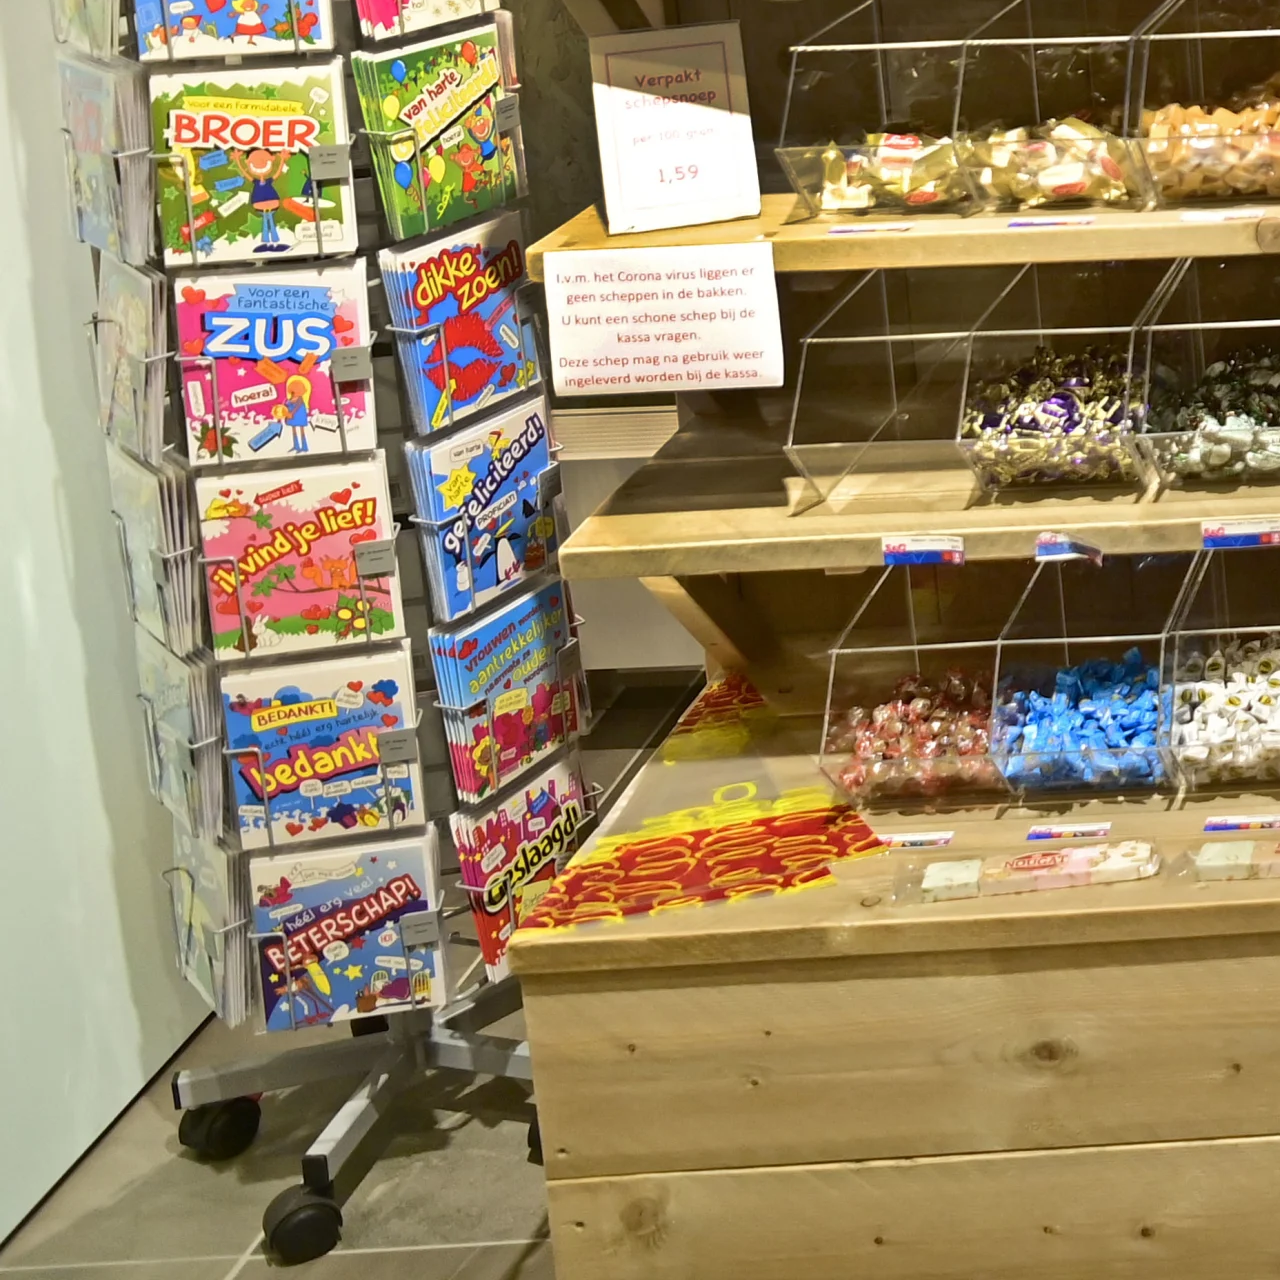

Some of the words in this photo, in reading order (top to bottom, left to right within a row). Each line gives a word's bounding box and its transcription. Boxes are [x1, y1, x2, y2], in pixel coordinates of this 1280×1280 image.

[635, 68, 702, 89] Verpakt
[188, 100, 211, 108] voor
[235, 100, 298, 113] formidabele
[403, 98, 427, 120] van
[426, 71, 458, 101] harte
[625, 90, 717, 110] schepsnoep
[174, 113, 316, 148] BROER
[443, 130, 462, 143] hoera!
[659, 164, 699, 185] 1,59
[416, 252, 477, 306] dikke
[457, 246, 519, 311] zoen!
[594, 272, 614, 282] het
[618, 271, 662, 282] Corona
[666, 270, 696, 280] virus
[700, 267, 738, 280] liggen
[742, 267, 754, 276] er
[237, 297, 330, 311] fantastische
[284, 288, 310, 298] een
[567, 293, 596, 305] geen
[600, 290, 658, 303] scheppen
[663, 289, 673, 300] in
[678, 288, 693, 299] de
[697, 286, 747, 298] bakken.
[562, 316, 571, 326] U
[575, 314, 601, 325] kunt
[605, 316, 628, 324] een
[633, 312, 676, 323] schone
[680, 311, 717, 322] schep
[720, 309, 736, 320] bij
[740, 308, 755, 319] de
[206, 317, 331, 357] ZUS
[617, 332, 650, 343] kassa
[654, 332, 701, 343] vragen.
[559, 357, 589, 368] Deze
[593, 356, 628, 368] schep
[633, 355, 659, 366] mag
[664, 354, 678, 363] na
[682, 352, 729, 365] gebruik
[733, 350, 764, 360] weer
[565, 374, 630, 388] ingeleverd
[635, 371, 683, 383] worden
[687, 370, 701, 383] bij
[706, 368, 720, 379] de
[725, 368, 762, 378] kassa.
[234, 387, 274, 404] hoera!
[454, 449, 465, 457] van
[444, 417, 544, 554] gefeliciteerd!
[447, 473, 461, 493] van
[449, 476, 471, 502] harte
[259, 491, 281, 504] super
[477, 493, 516, 525] PROFICIAT!
[213, 568, 245, 594] ik
[239, 529, 291, 573] vind
[287, 522, 320, 555] je
[319, 500, 374, 533] lief!
[465, 622, 516, 672] vrouwen
[518, 603, 543, 626] worden
[469, 607, 562, 694] aantrekkelijker
[484, 657, 521, 695] naarmate
[522, 649, 531, 661] ze
[512, 643, 552, 682] ouder
[257, 701, 334, 727] BEDANKT!
[264, 737, 286, 750] echt
[315, 721, 333, 733] erg
[335, 709, 379, 727] hartelijk
[488, 806, 580, 906] Geslaagd!
[1004, 854, 1067, 869] NOUGAT
[320, 897, 343, 913] erg
[344, 876, 374, 897] veel
[267, 877, 419, 970] BETERSCHAP!
